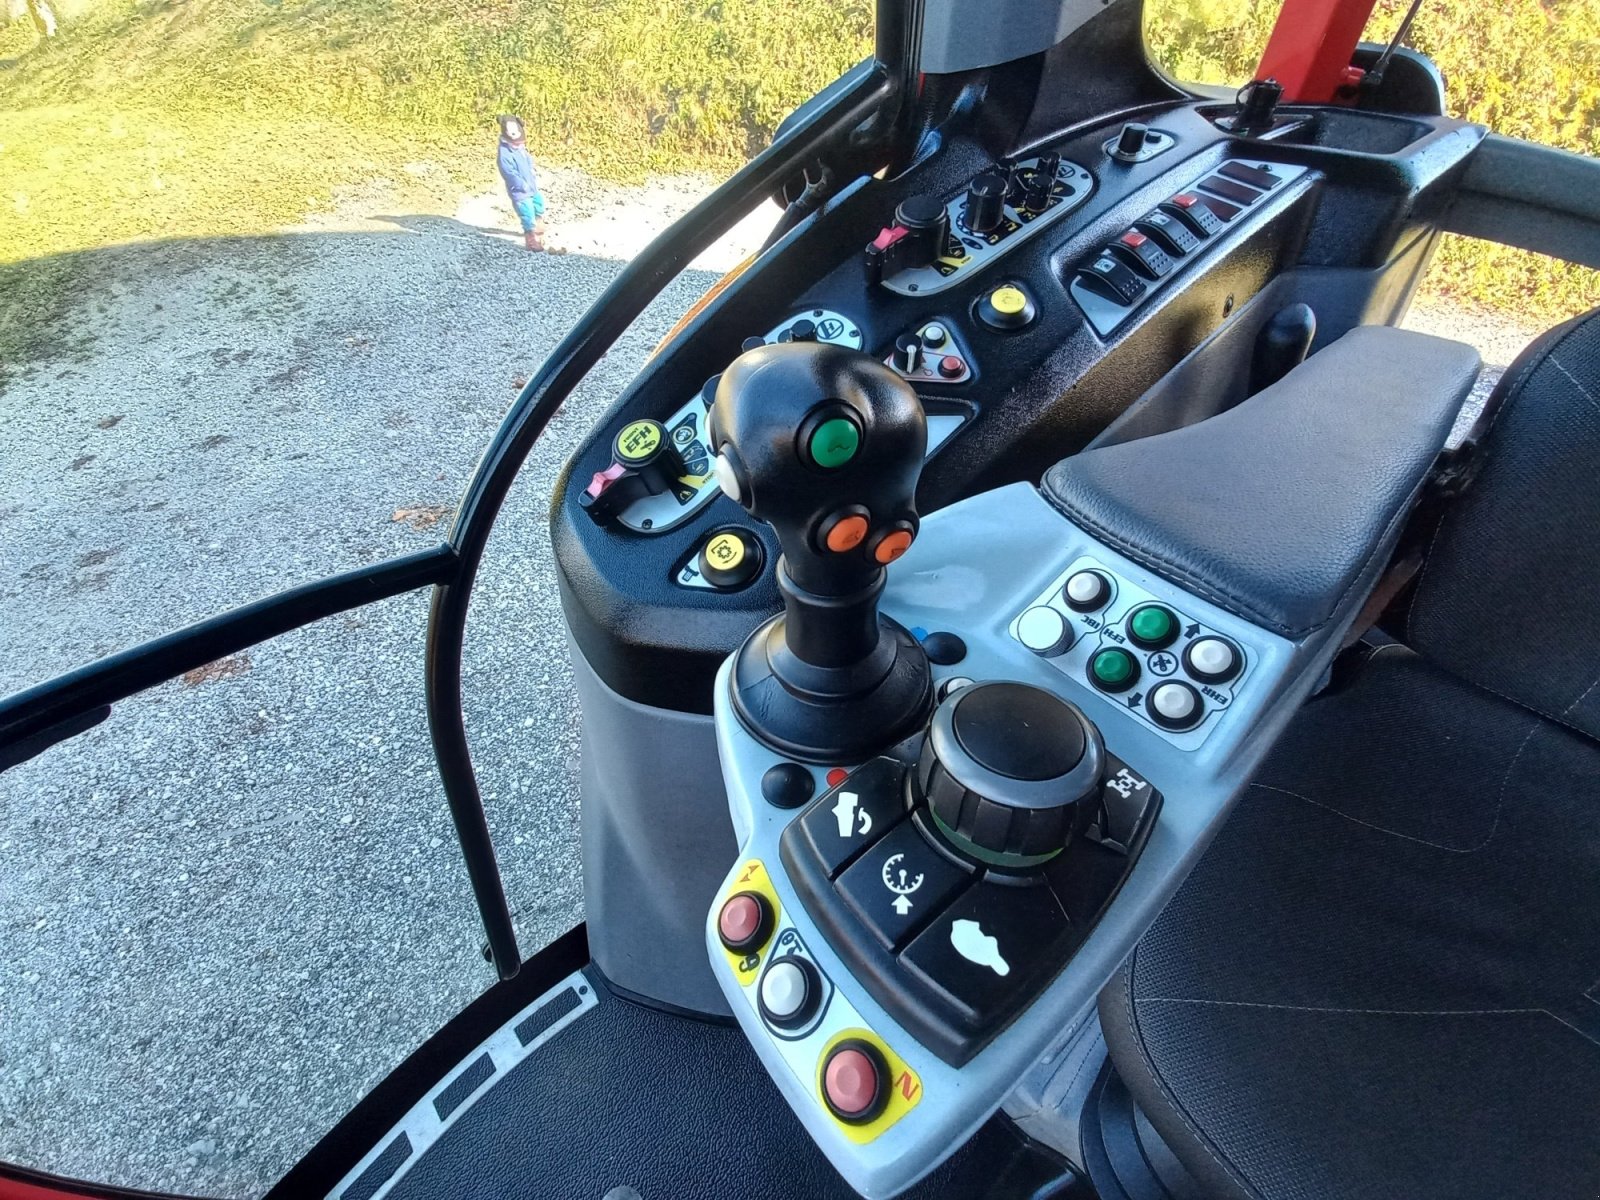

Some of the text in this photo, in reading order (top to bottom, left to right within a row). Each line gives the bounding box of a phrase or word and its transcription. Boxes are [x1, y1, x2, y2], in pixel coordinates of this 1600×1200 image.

[625, 426, 652, 453] EFH
[1080, 615, 1100, 630] IBC
[1103, 628, 1126, 645] EFH
[1201, 685, 1229, 705] EHR
